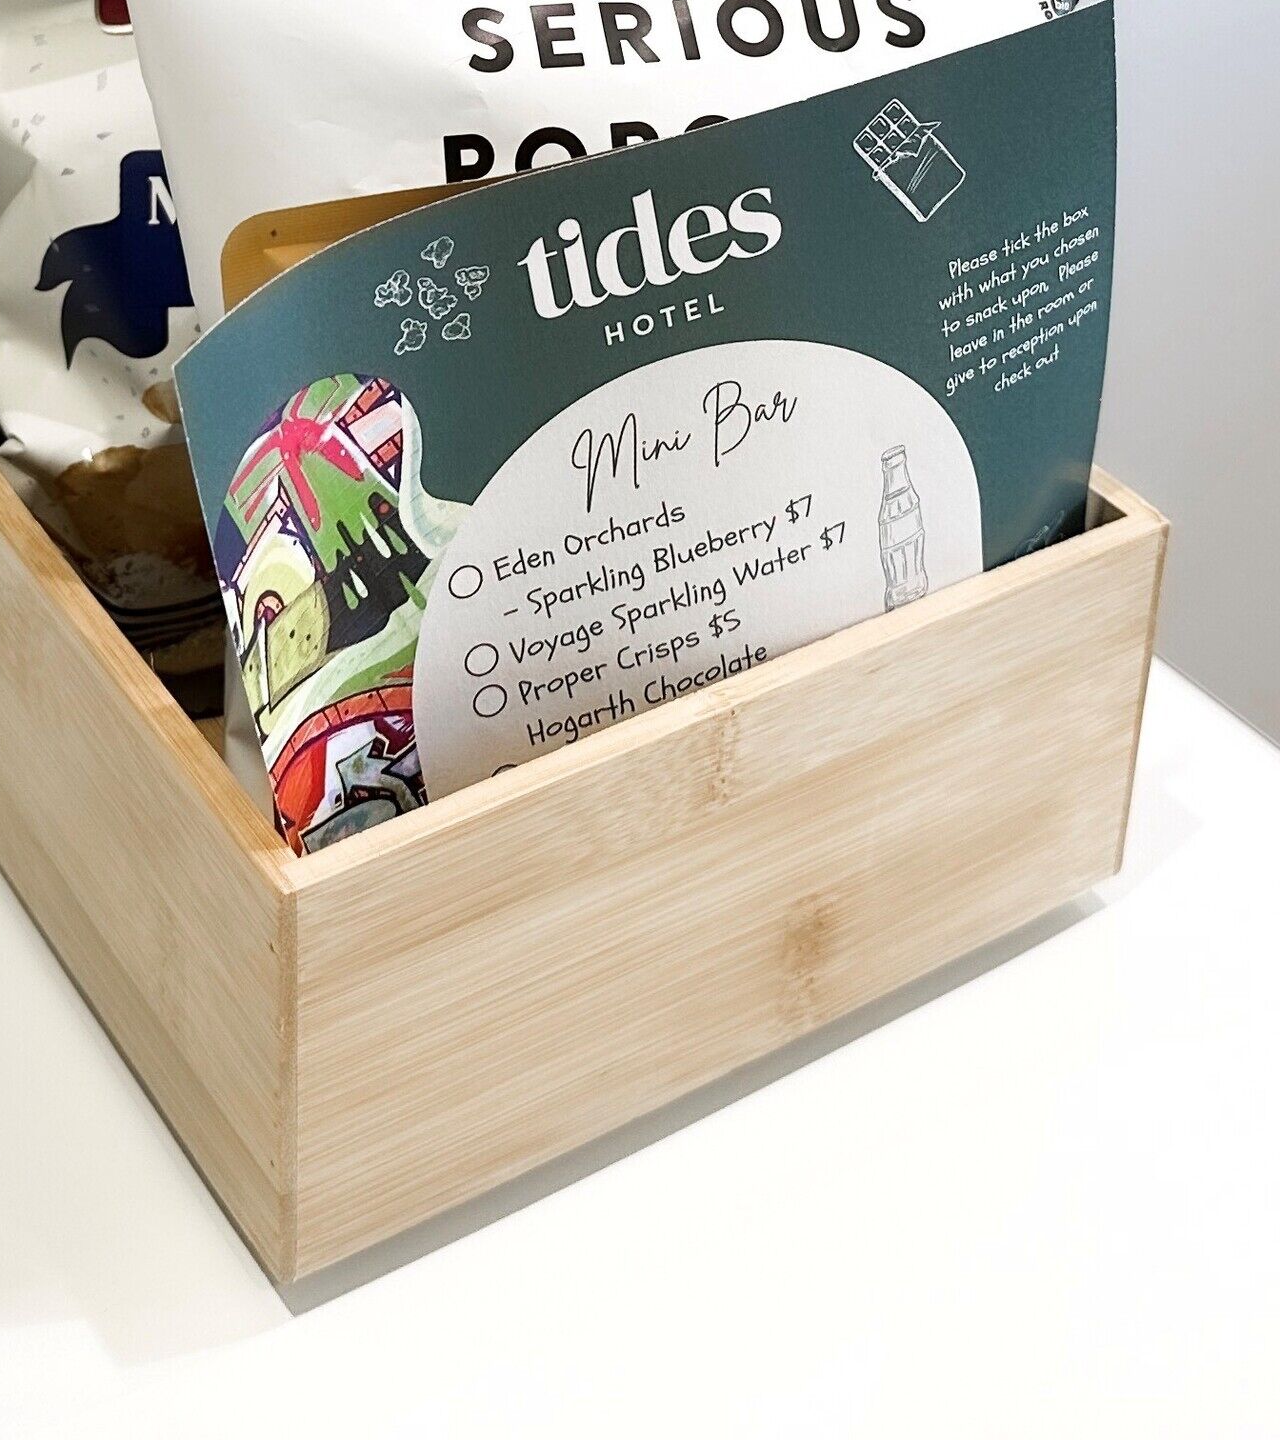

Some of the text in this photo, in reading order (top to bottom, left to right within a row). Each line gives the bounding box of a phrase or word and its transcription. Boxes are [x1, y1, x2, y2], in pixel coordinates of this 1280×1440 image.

[517, 187, 782, 319] tides
[938, 226, 1099, 311] with what you chosen
[948, 206, 1090, 280] Please tick the box
[604, 293, 725, 346] HOTEL
[941, 319, 961, 338] to
[965, 295, 1009, 328] snack
[1058, 250, 1099, 282] Please
[948, 277, 1095, 362] leave in the room or
[945, 298, 1098, 398] give to reception upon
[994, 343, 1060, 393] check out
[571, 379, 798, 514] Mini Bar
[493, 501, 686, 582] Eden Orchards
[526, 563, 646, 619] Sparkling
[652, 515, 777, 574] Blueberry
[784, 493, 814, 524] $7
[508, 521, 847, 664] Voyage Sparkling Water $7
[518, 608, 742, 706] Proper Crisps $5
[526, 643, 768, 747] Hogarth Chocolate
